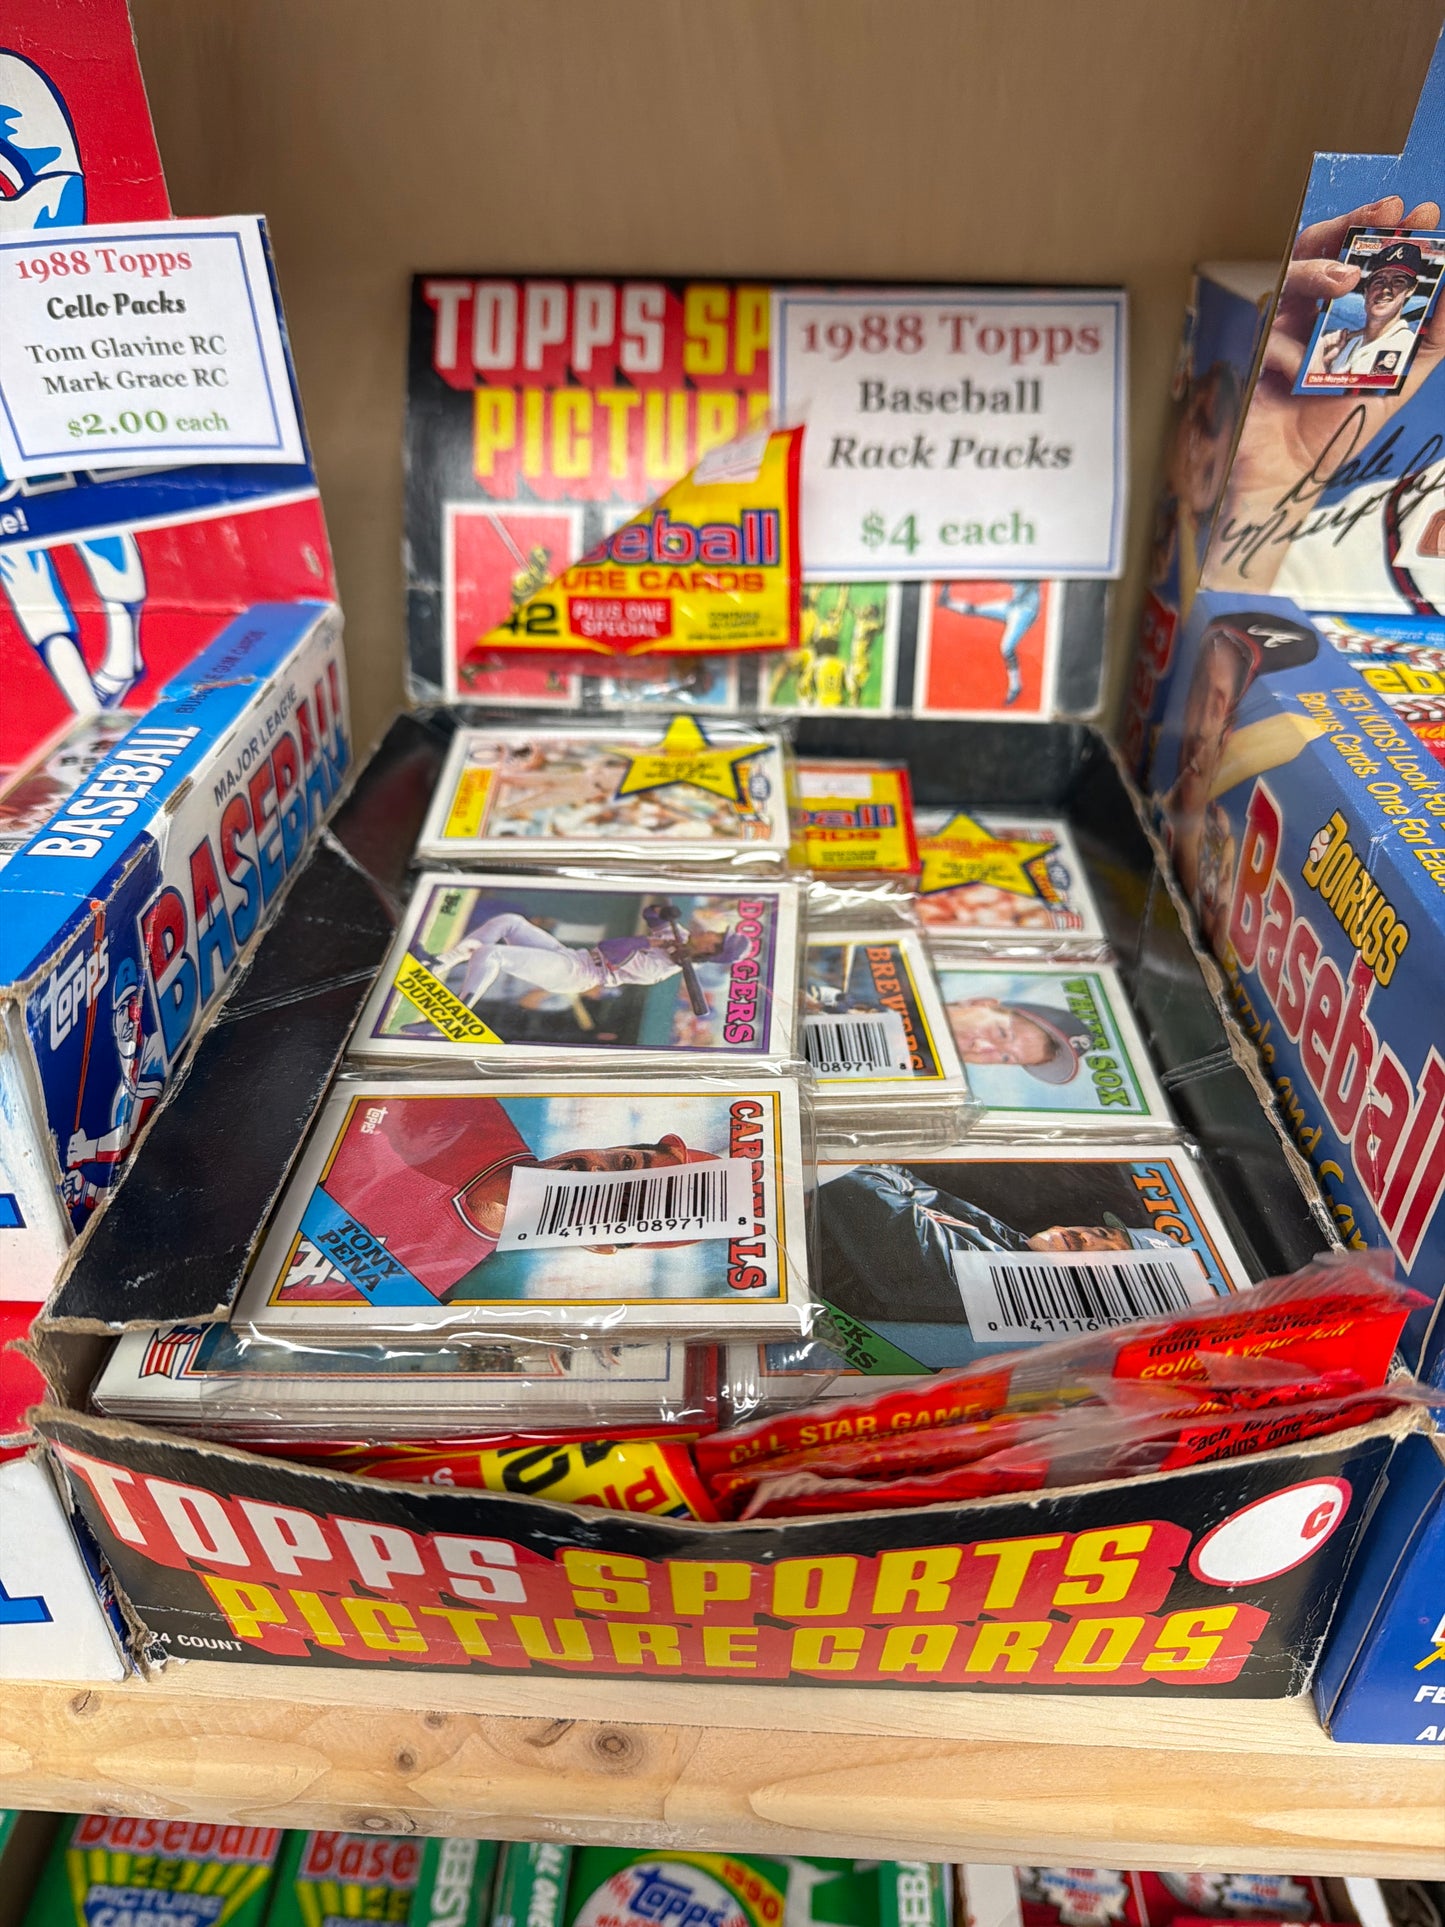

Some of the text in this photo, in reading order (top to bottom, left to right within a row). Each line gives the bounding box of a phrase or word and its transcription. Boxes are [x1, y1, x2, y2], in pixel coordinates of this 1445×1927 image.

[15, 248, 193, 284] 1988 Topps
[46, 290, 187, 320] Cello Packs
[425, 281, 667, 374] TOPPS
[802, 311, 1103, 366] 1988 Topps
[24, 335, 227, 365] Tom Glavine RC
[41, 368, 229, 395] Mark Grace RC
[858, 377, 1042, 414] Baseball
[67, 410, 231, 437] $2.00 each
[827, 434, 1074, 470] Rack Packs
[860, 509, 1037, 555] $4 each
[639, 570, 765, 592] CARDS
[1332, 687, 1379, 712] HEY
[1354, 714, 1413, 752] KIDS!
[213, 732, 260, 807] MAJOR
[1297, 692, 1345, 733] Bonus
[1366, 781, 1411, 816] One
[1391, 817, 1435, 847] For
[1385, 753, 1441, 791] Look
[25, 724, 201, 859] BASEBALL
[137, 659, 354, 1065] BASEBALL
[41, 936, 109, 1052] Topps
[398, 977, 470, 1040] DUNCAN
[409, 967, 486, 1037] MARIANO
[819, 1060, 874, 1073] 08971
[1085, 1055, 1131, 1106] SOX
[517, 1216, 748, 1242] 0 41116 08971 8
[316, 1229, 383, 1292] PENA
[338, 1218, 405, 1280] TONY
[988, 1321, 998, 1332] 0
[1029, 1318, 1100, 1333] 41116
[799, 1416, 877, 1446] STAR
[57, 1444, 1154, 1616] TOPPS SPORTS
[203, 1573, 1239, 1673] PICTURE CARDS
[177, 1634, 244, 1652] COUNT
